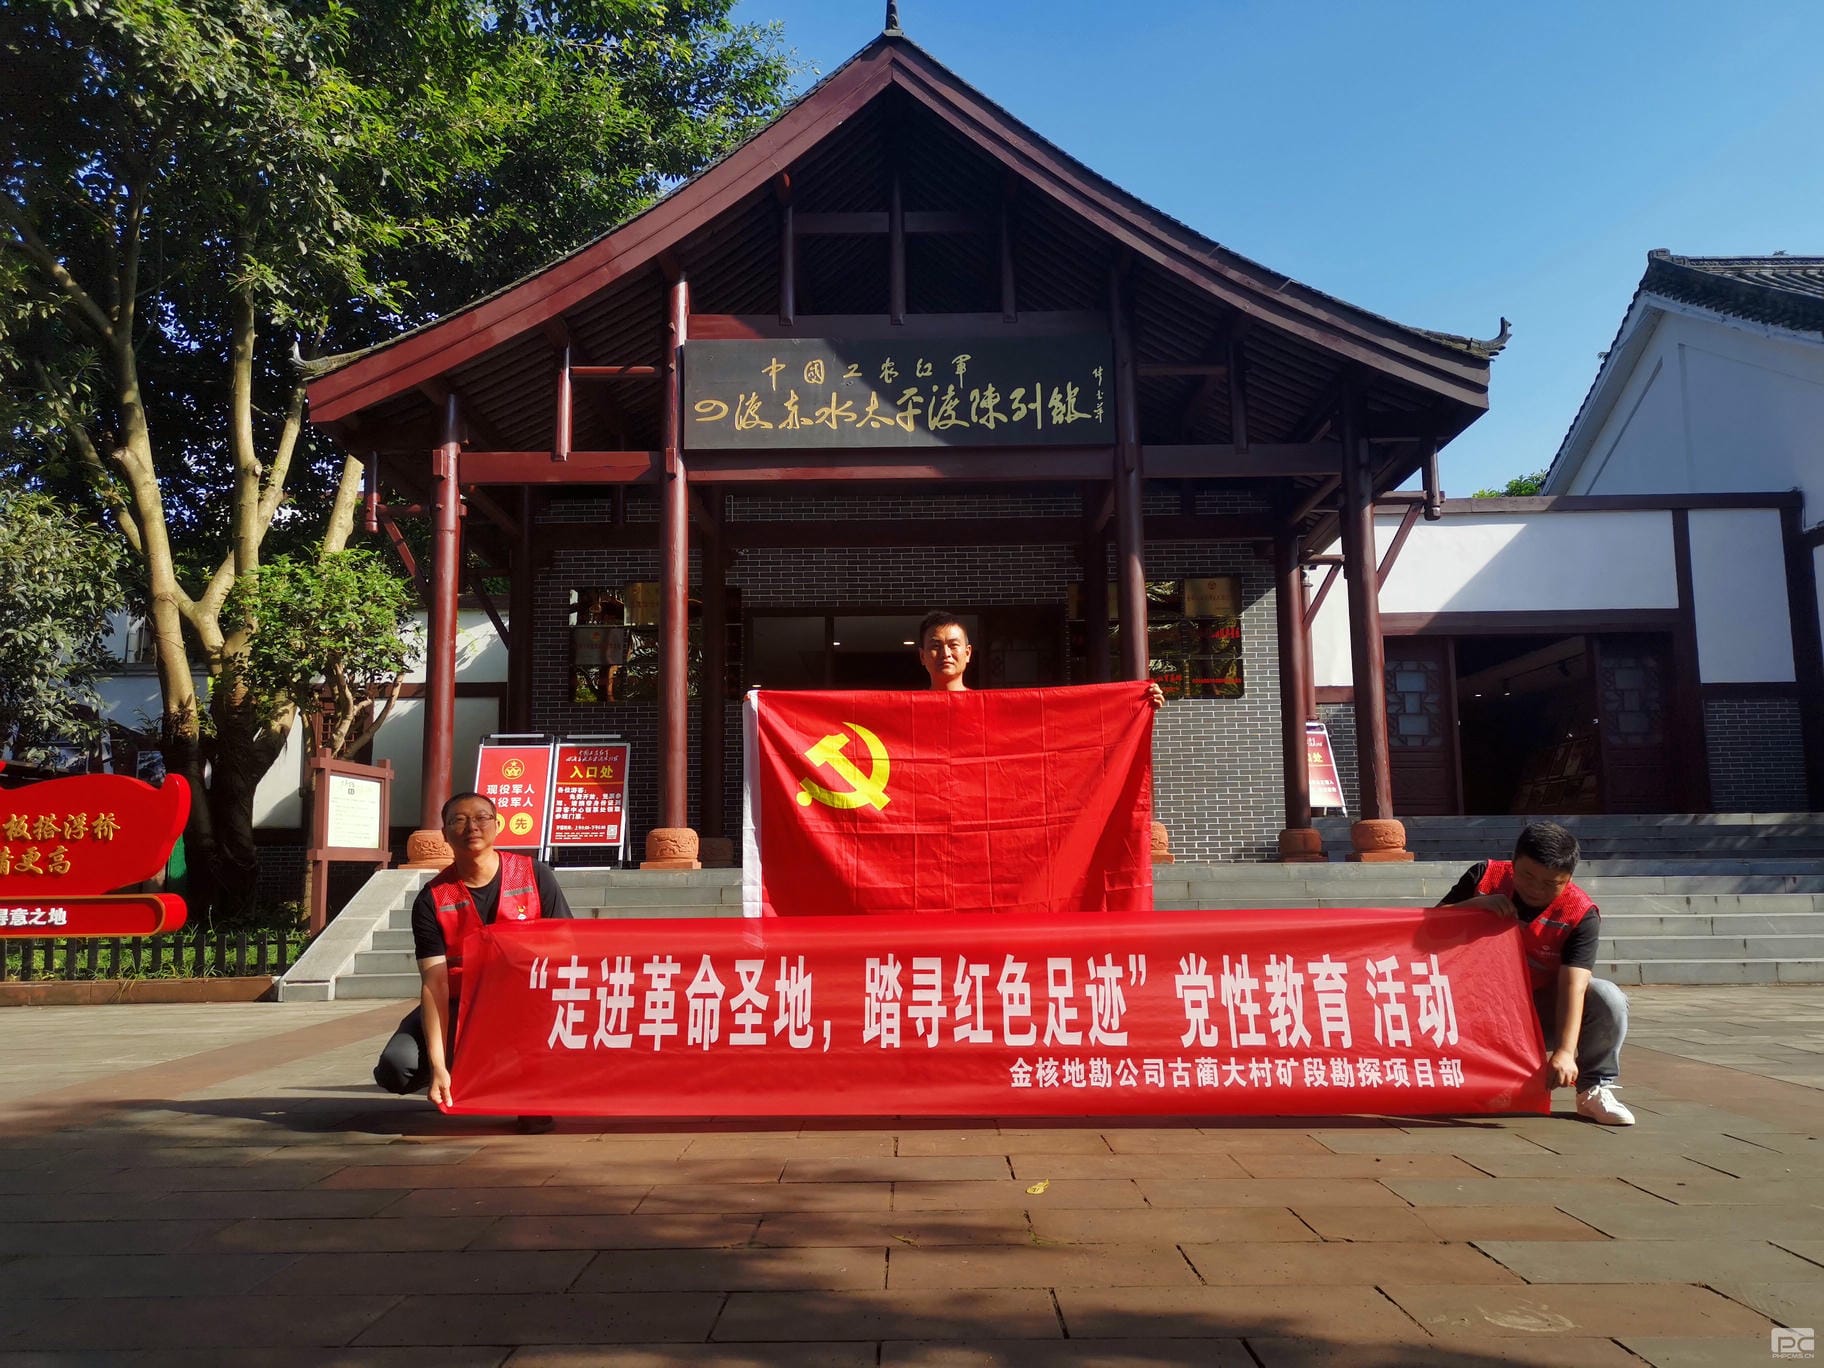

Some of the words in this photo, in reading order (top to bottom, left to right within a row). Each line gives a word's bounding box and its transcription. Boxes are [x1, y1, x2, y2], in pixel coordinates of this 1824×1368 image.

[569, 765, 614, 779] 入口处
[486, 783, 535, 795] 现役军人
[2, 812, 121, 841] 板搭浮桥
[514, 817, 528, 830] 先
[1009, 1056, 1466, 1089] 金核地勘公司古蔺大村矿段勘探项目部
